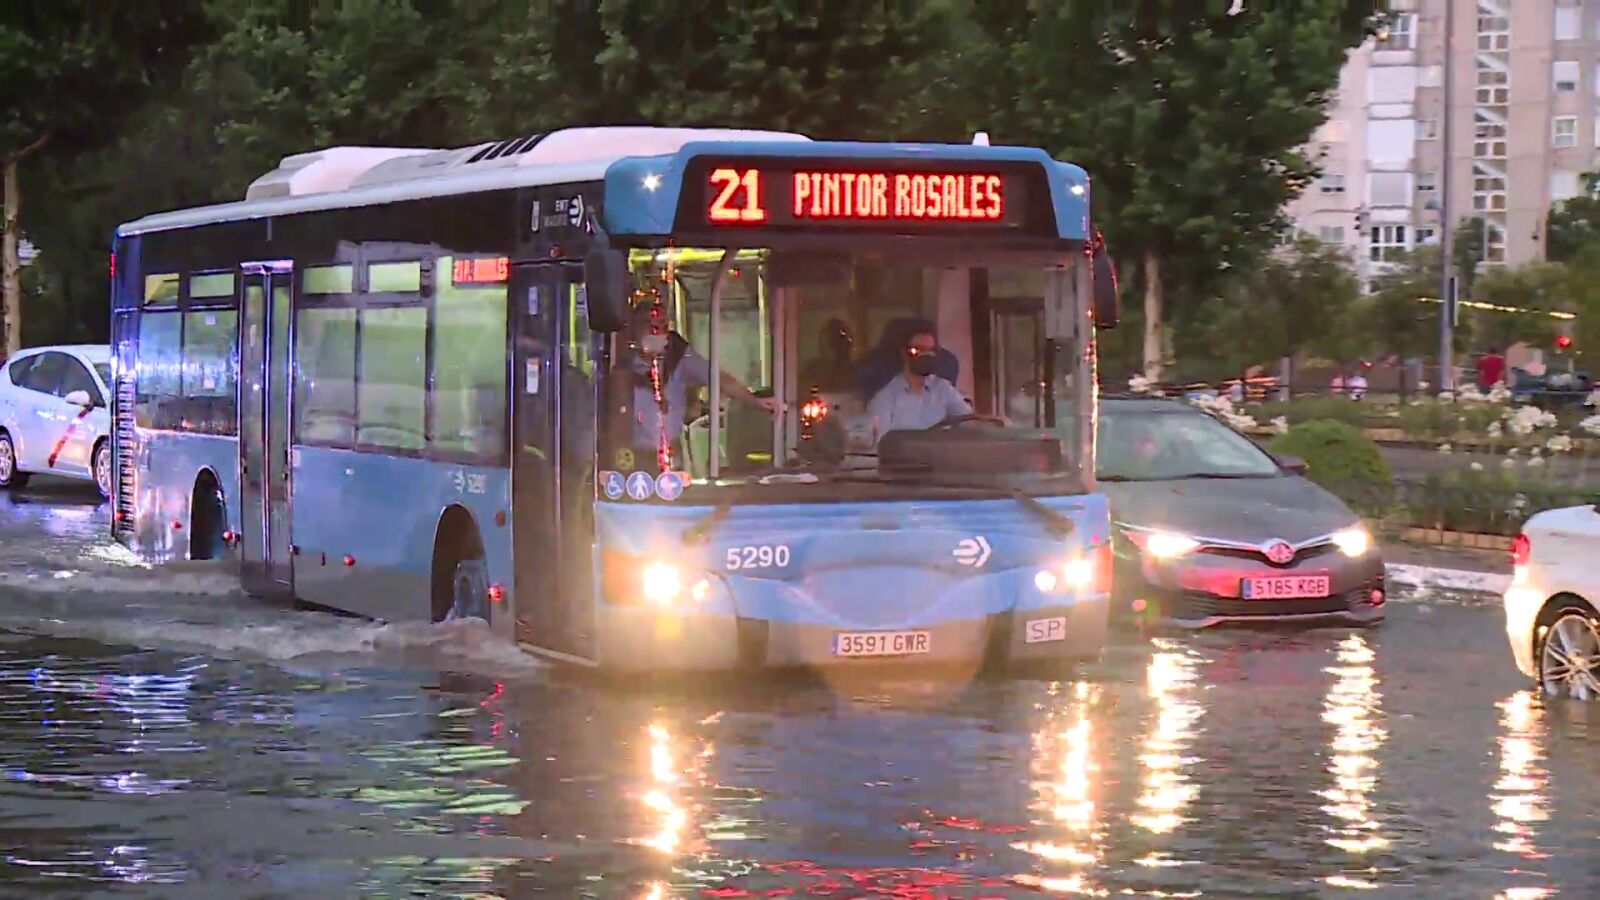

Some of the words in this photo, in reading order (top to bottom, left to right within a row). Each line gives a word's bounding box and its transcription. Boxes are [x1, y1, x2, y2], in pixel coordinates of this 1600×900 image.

[709, 168, 765, 221] 21
[793, 172, 888, 217] PINTOR
[895, 173, 1001, 219] ROSALES
[726, 545, 790, 570] 5290
[1255, 578, 1293, 596] 5185
[1298, 576, 1326, 594] KGB
[1031, 620, 1062, 641] SP
[841, 635, 887, 654] 3591
[893, 633, 928, 652] GWR
